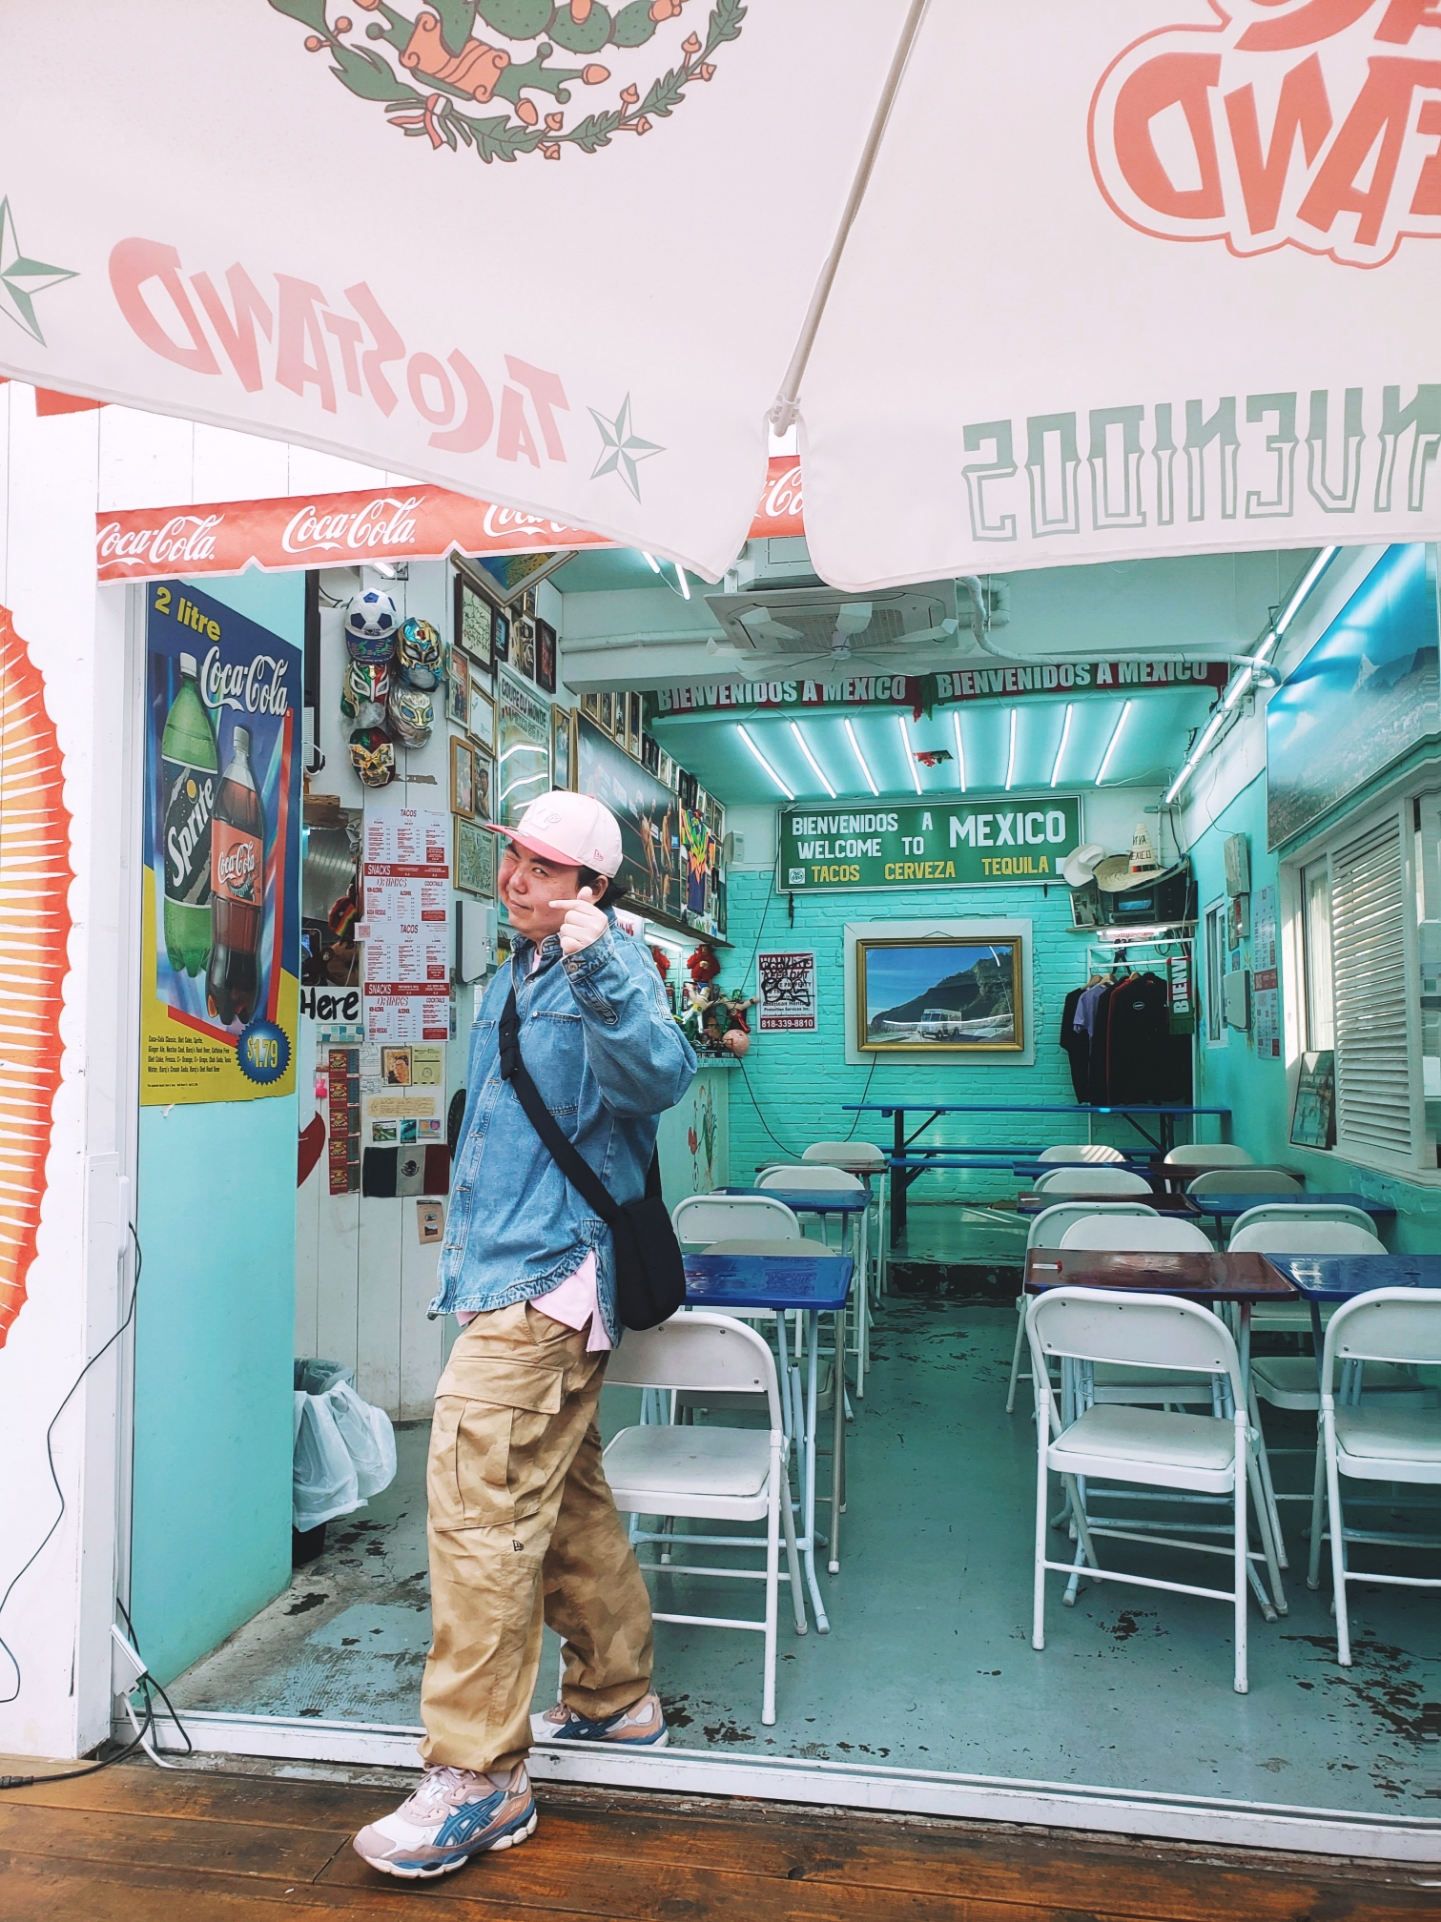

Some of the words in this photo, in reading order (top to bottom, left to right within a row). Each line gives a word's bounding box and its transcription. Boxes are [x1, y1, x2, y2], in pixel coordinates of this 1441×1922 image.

[97, 513, 225, 569] Coca-Cola
[282, 496, 425, 554] Coca-Cola
[155, 586, 172, 615] 2
[177, 596, 221, 642] litre
[200, 645, 289, 716] Coca-Cola
[657, 680, 798, 711] BIENVENIDOS
[802, 680, 818, 702] A
[823, 675, 906, 700] MEXICO
[936, 663, 1091, 698] BIENVENIDOS
[1096, 662, 1113, 684] A
[167, 778, 215, 888] Sprite
[792, 813, 898, 835] BIENVENIDOS
[922, 812, 933, 831] A
[949, 810, 1066, 848] MEXICO
[218, 841, 256, 884] Coca-Cola
[797, 838, 882, 859] WELCOME
[901, 836, 924, 855] TO
[368, 864, 390, 876] SNACKS
[811, 865, 860, 882] TACOS
[884, 860, 956, 880] CERVEZA
[981, 856, 1049, 875] TEQUILA
[300, 987, 360, 1020] Here
[368, 984, 392, 994] SNACKS
[761, 1019, 814, 1028] 818-339-8810
[247, 1035, 279, 1069] $1.79
